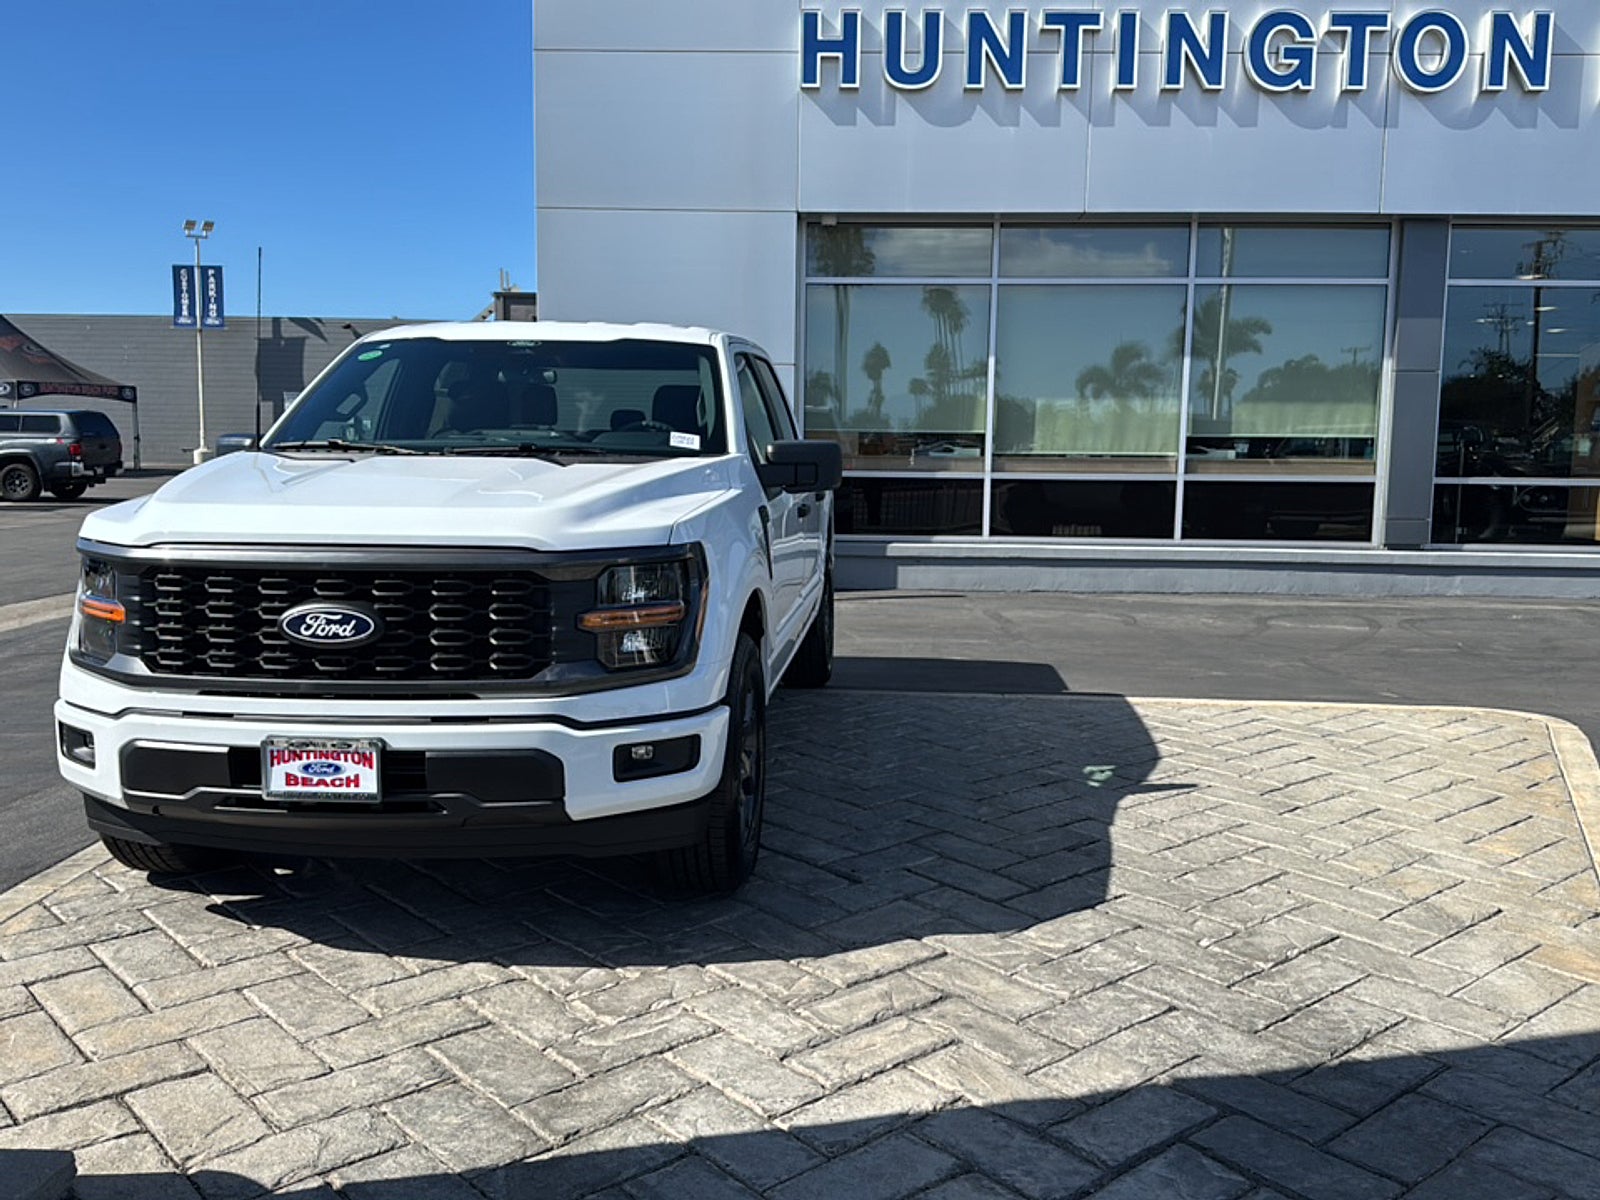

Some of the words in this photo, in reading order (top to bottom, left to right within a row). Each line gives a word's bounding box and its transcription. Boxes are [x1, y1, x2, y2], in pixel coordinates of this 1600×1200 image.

[800, 8, 1554, 93] HUNTINGTON
[207, 268, 217, 318] PARKING
[300, 612, 356, 637] Ford
[269, 749, 374, 769] HUNTINGTON
[307, 761, 336, 774] Ford
[285, 772, 360, 788] BEACH
